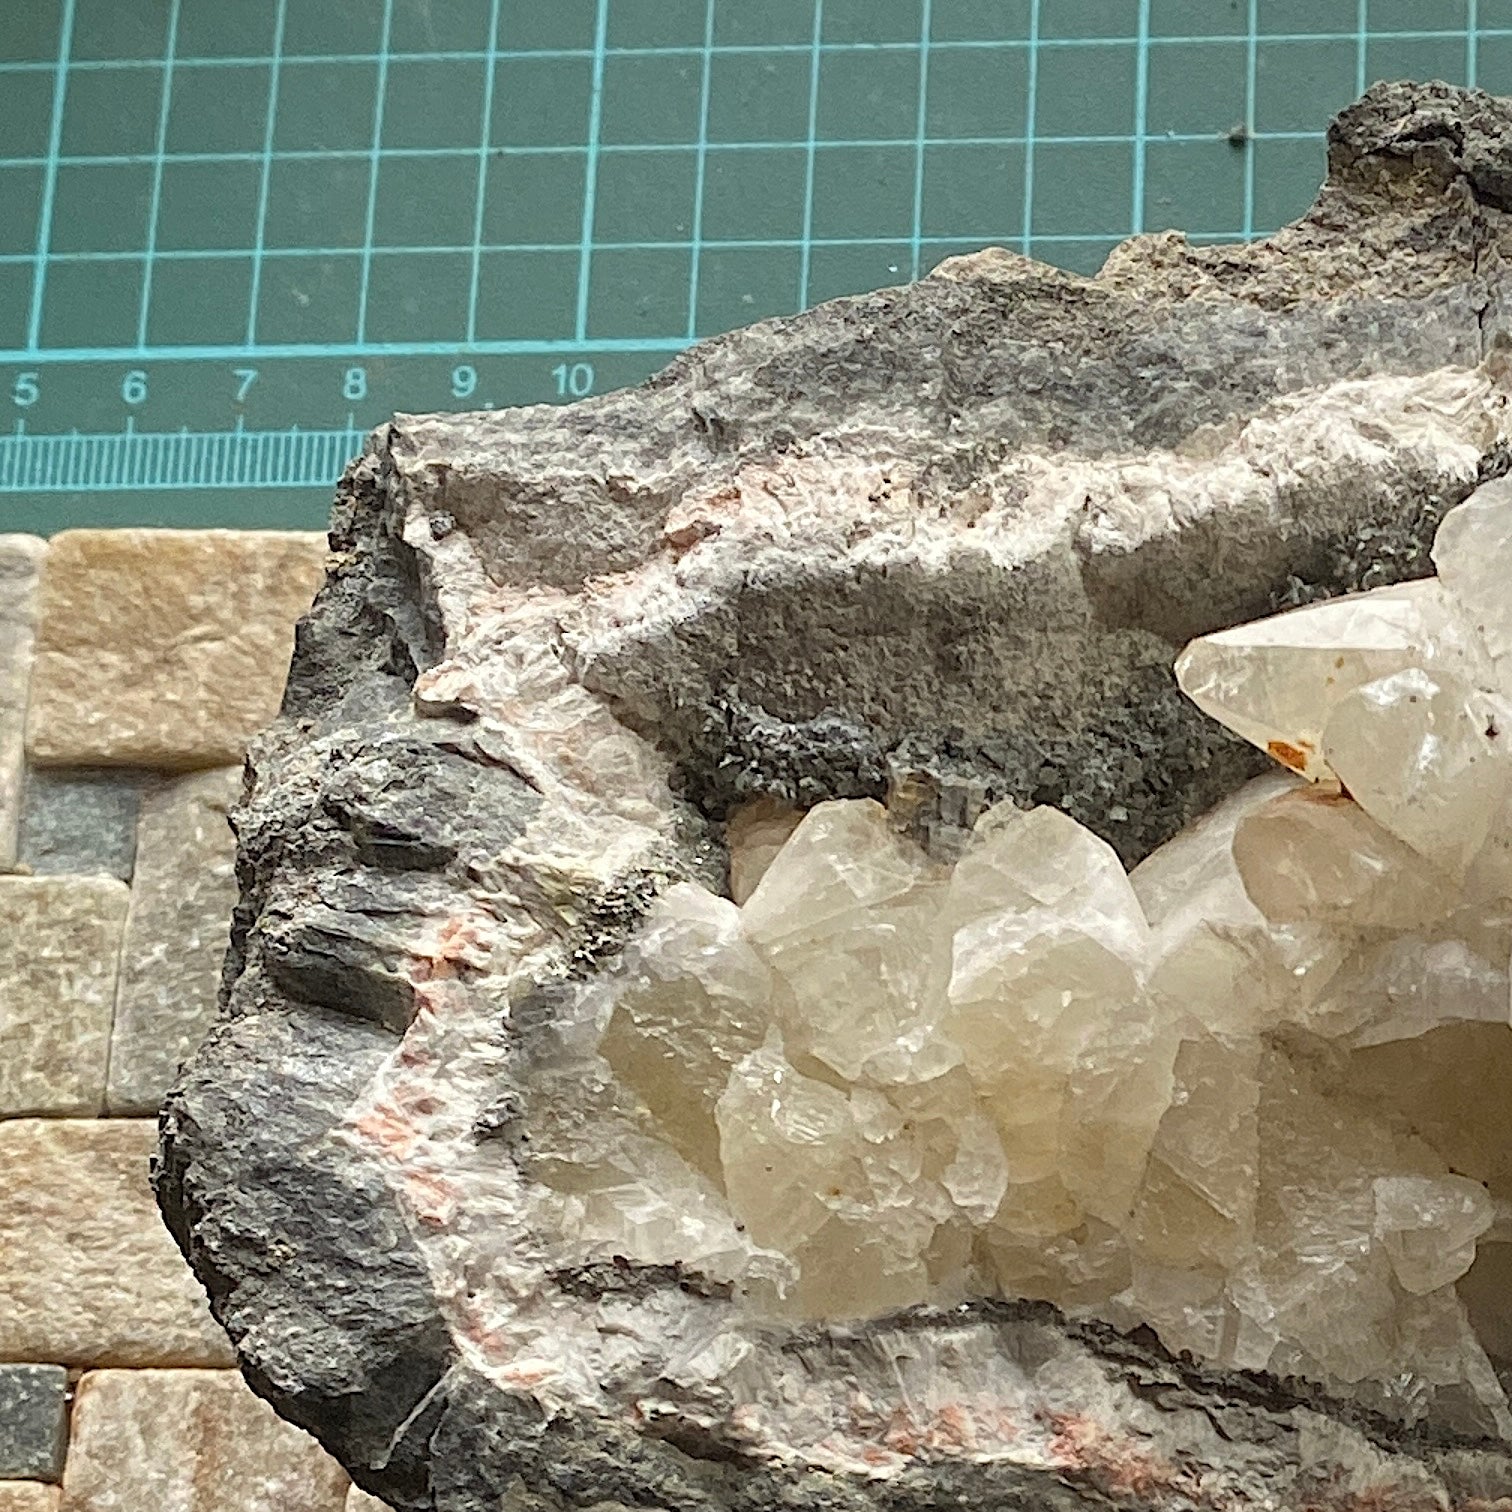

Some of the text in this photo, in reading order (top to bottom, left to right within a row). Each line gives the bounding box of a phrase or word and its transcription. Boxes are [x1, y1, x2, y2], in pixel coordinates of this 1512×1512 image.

[12, 363, 594, 404] 5 6 7 8 9 10
